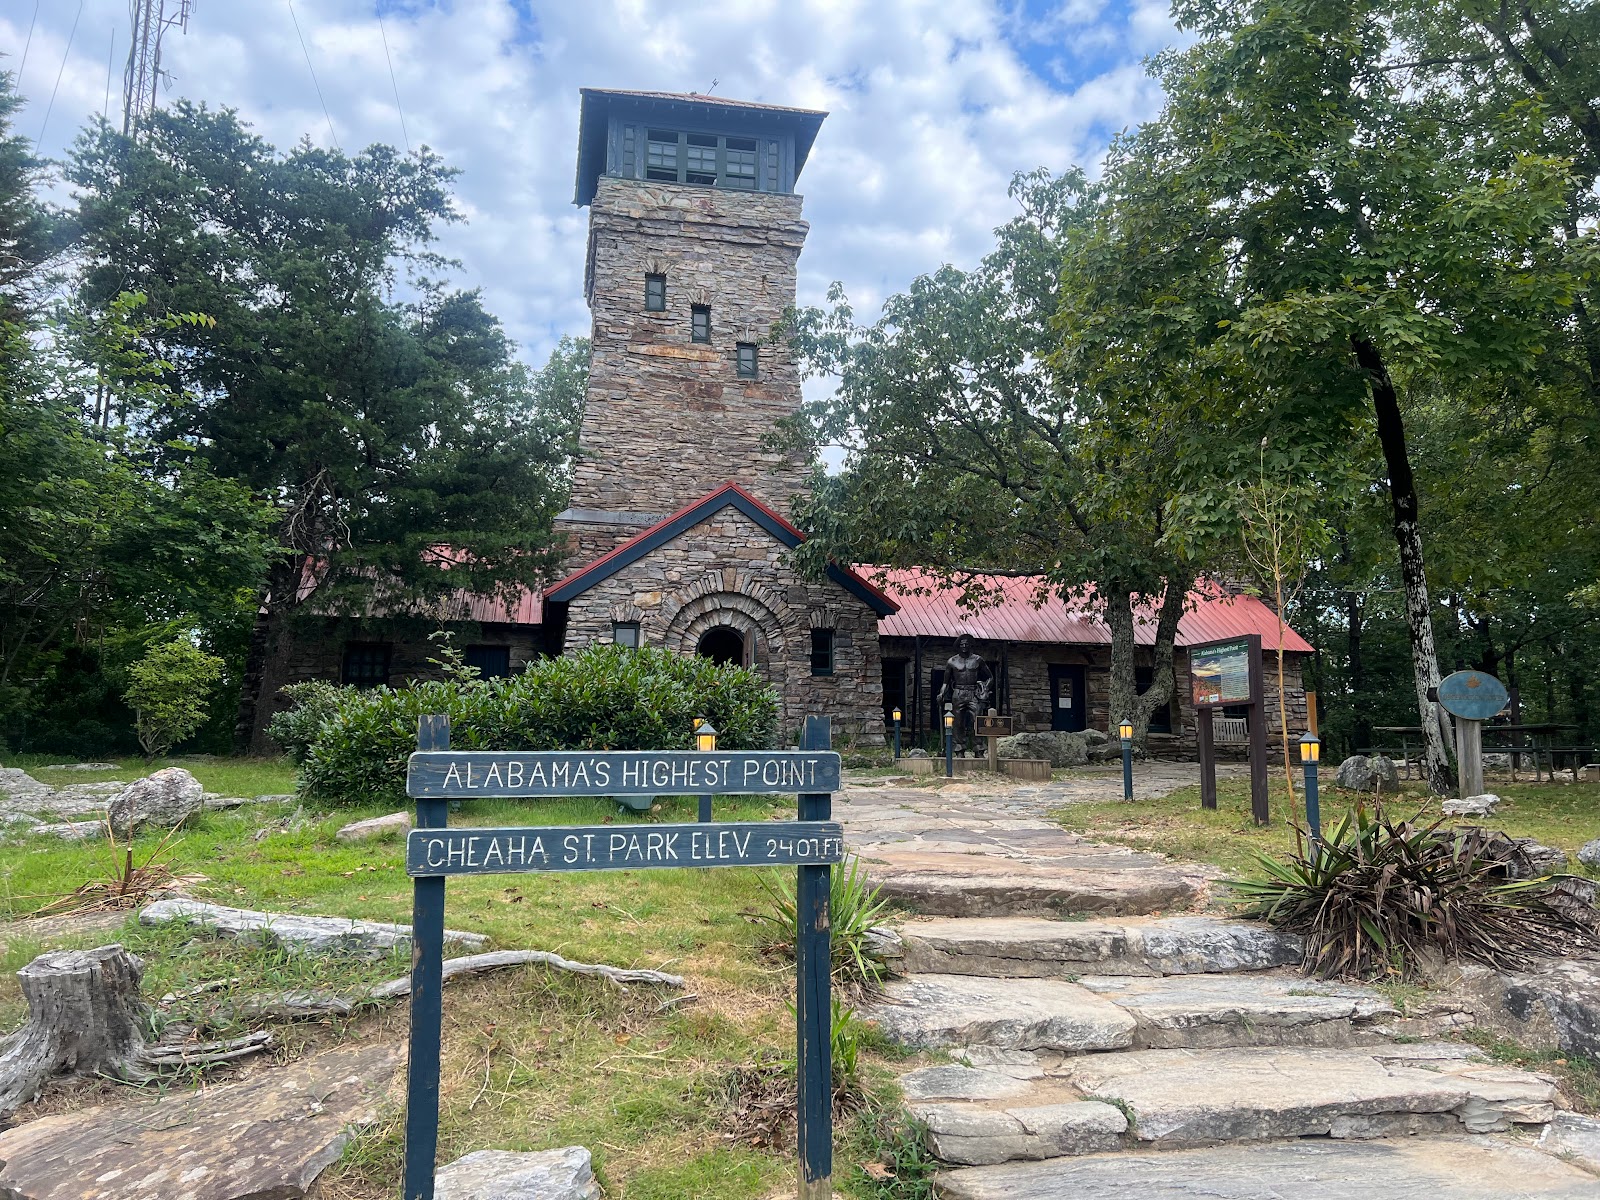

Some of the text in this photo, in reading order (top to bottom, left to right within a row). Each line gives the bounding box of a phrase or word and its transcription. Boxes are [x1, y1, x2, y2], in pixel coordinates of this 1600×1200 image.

[443, 758, 818, 789] ALABAMA'S HIGHEST POINT
[427, 836, 550, 867] CHEAHA
[563, 834, 596, 864] ST.
[609, 832, 679, 862] PARK
[691, 831, 751, 860] ELEV.
